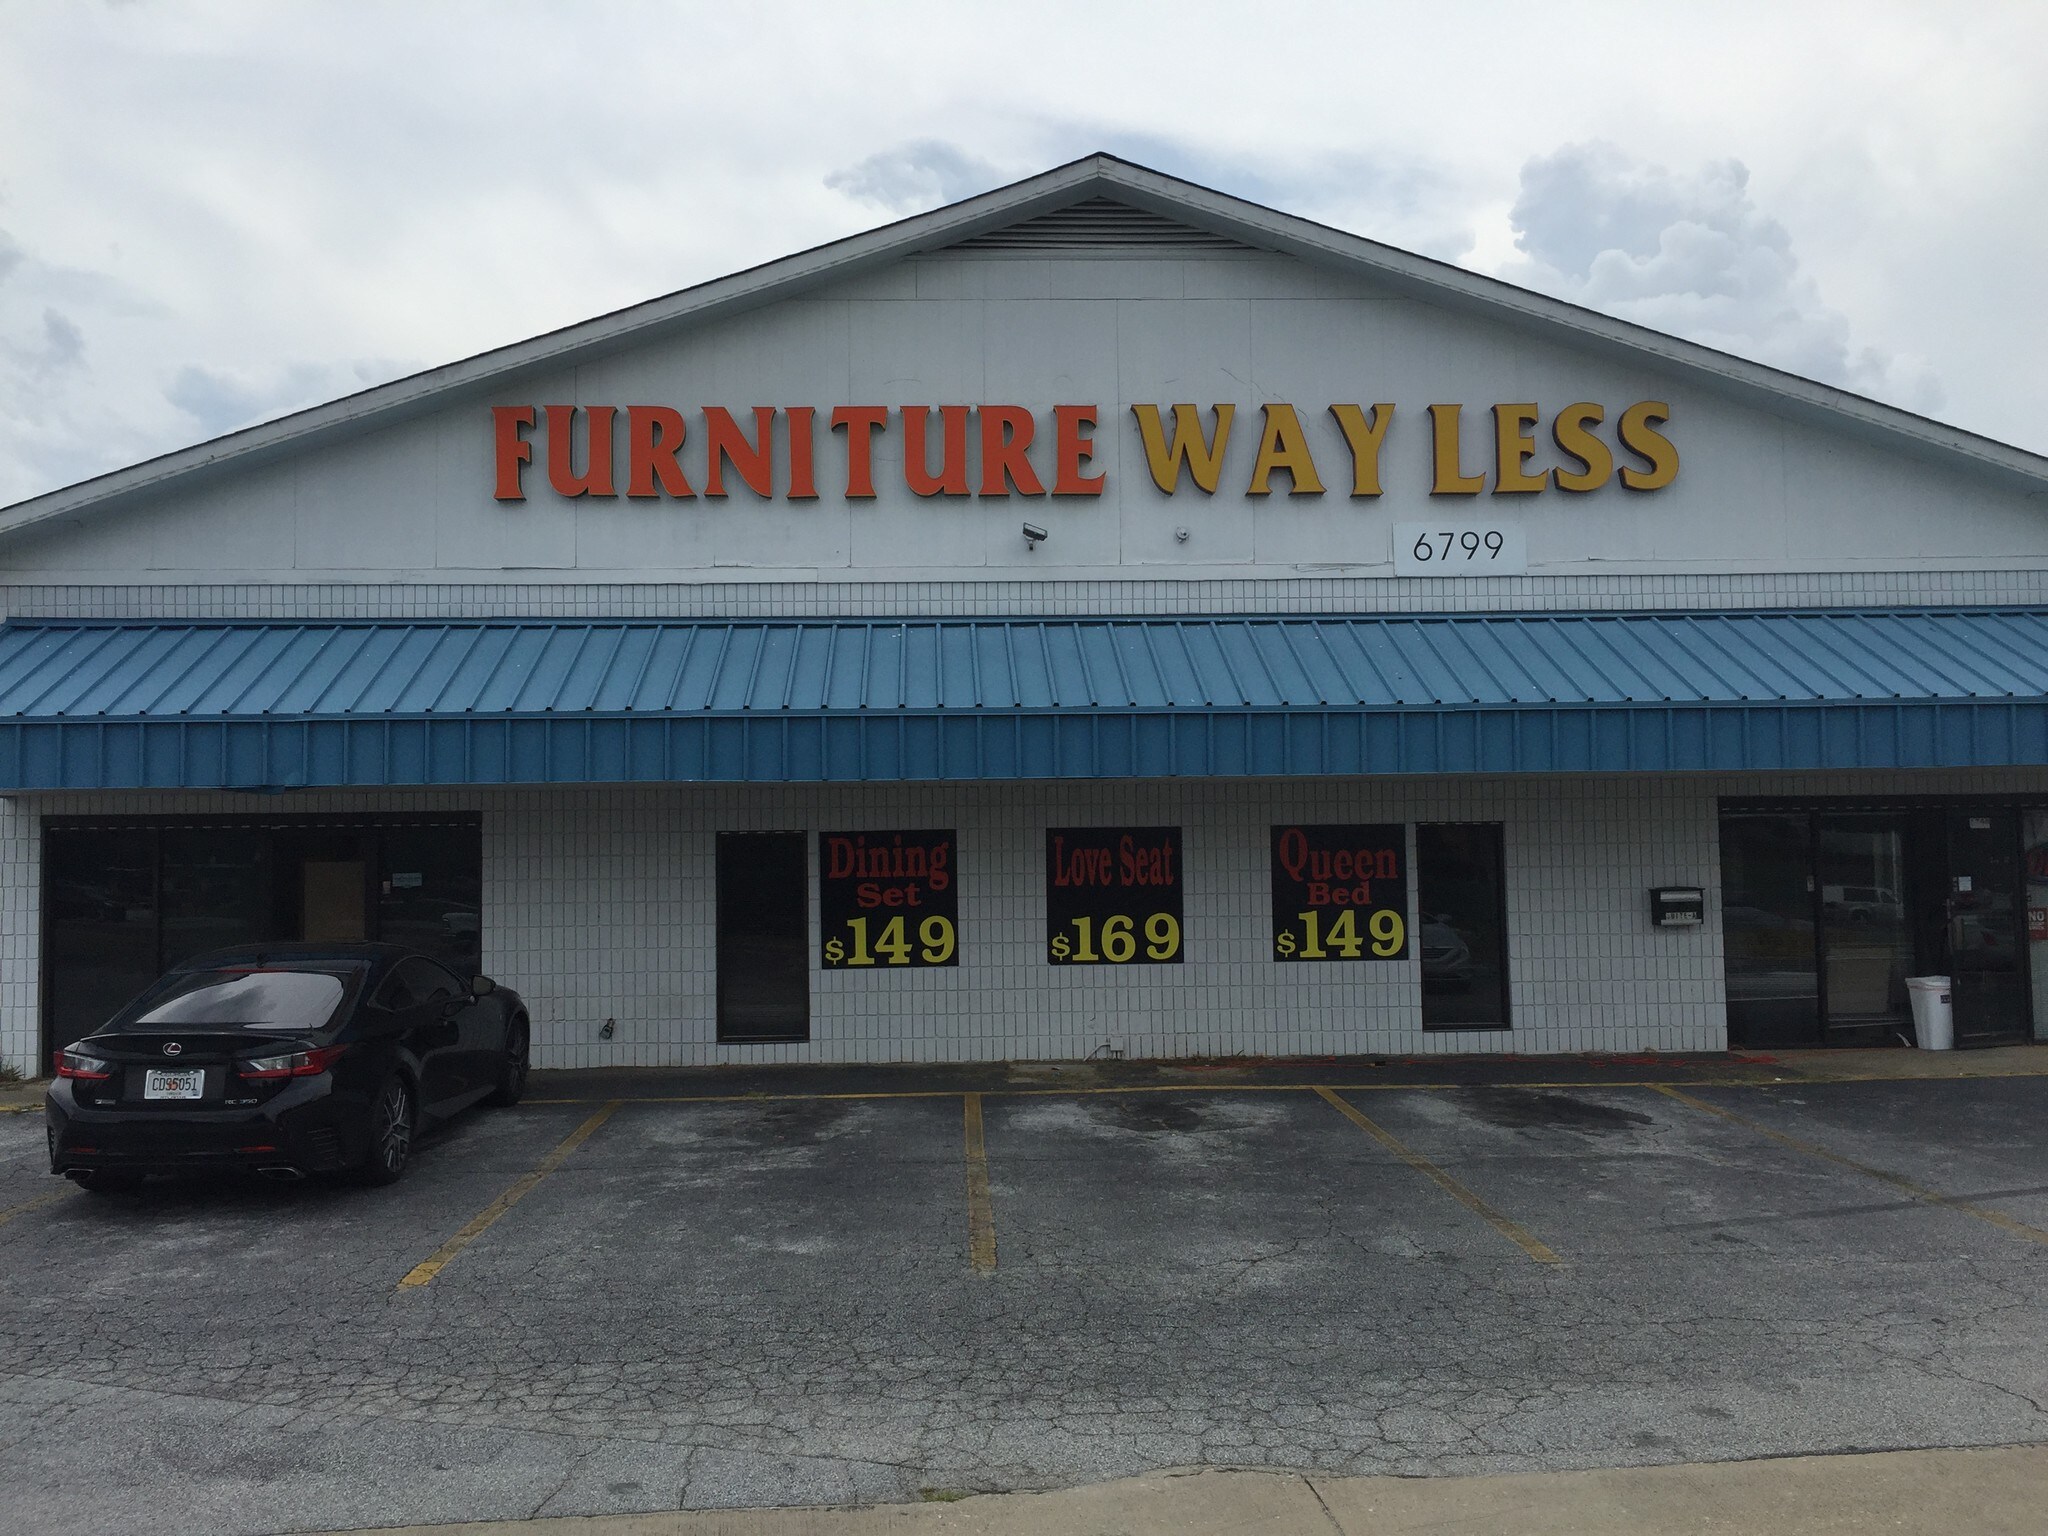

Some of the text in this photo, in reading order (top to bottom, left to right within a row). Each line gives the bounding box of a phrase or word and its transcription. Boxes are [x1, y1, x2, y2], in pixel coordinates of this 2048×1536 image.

[492, 401, 1680, 499] FURNITURE WAY LESS
[1413, 530, 1504, 561] 6799
[828, 836, 950, 890] Dining
[1055, 834, 1174, 886] Love Seat
[1279, 828, 1397, 881] Queen
[857, 882, 921, 908] Set
[1307, 881, 1372, 905] Bed
[2028, 911, 2045, 922] NO
[825, 915, 955, 965] $149
[1052, 912, 1180, 962] $169
[1277, 909, 1404, 957] $149
